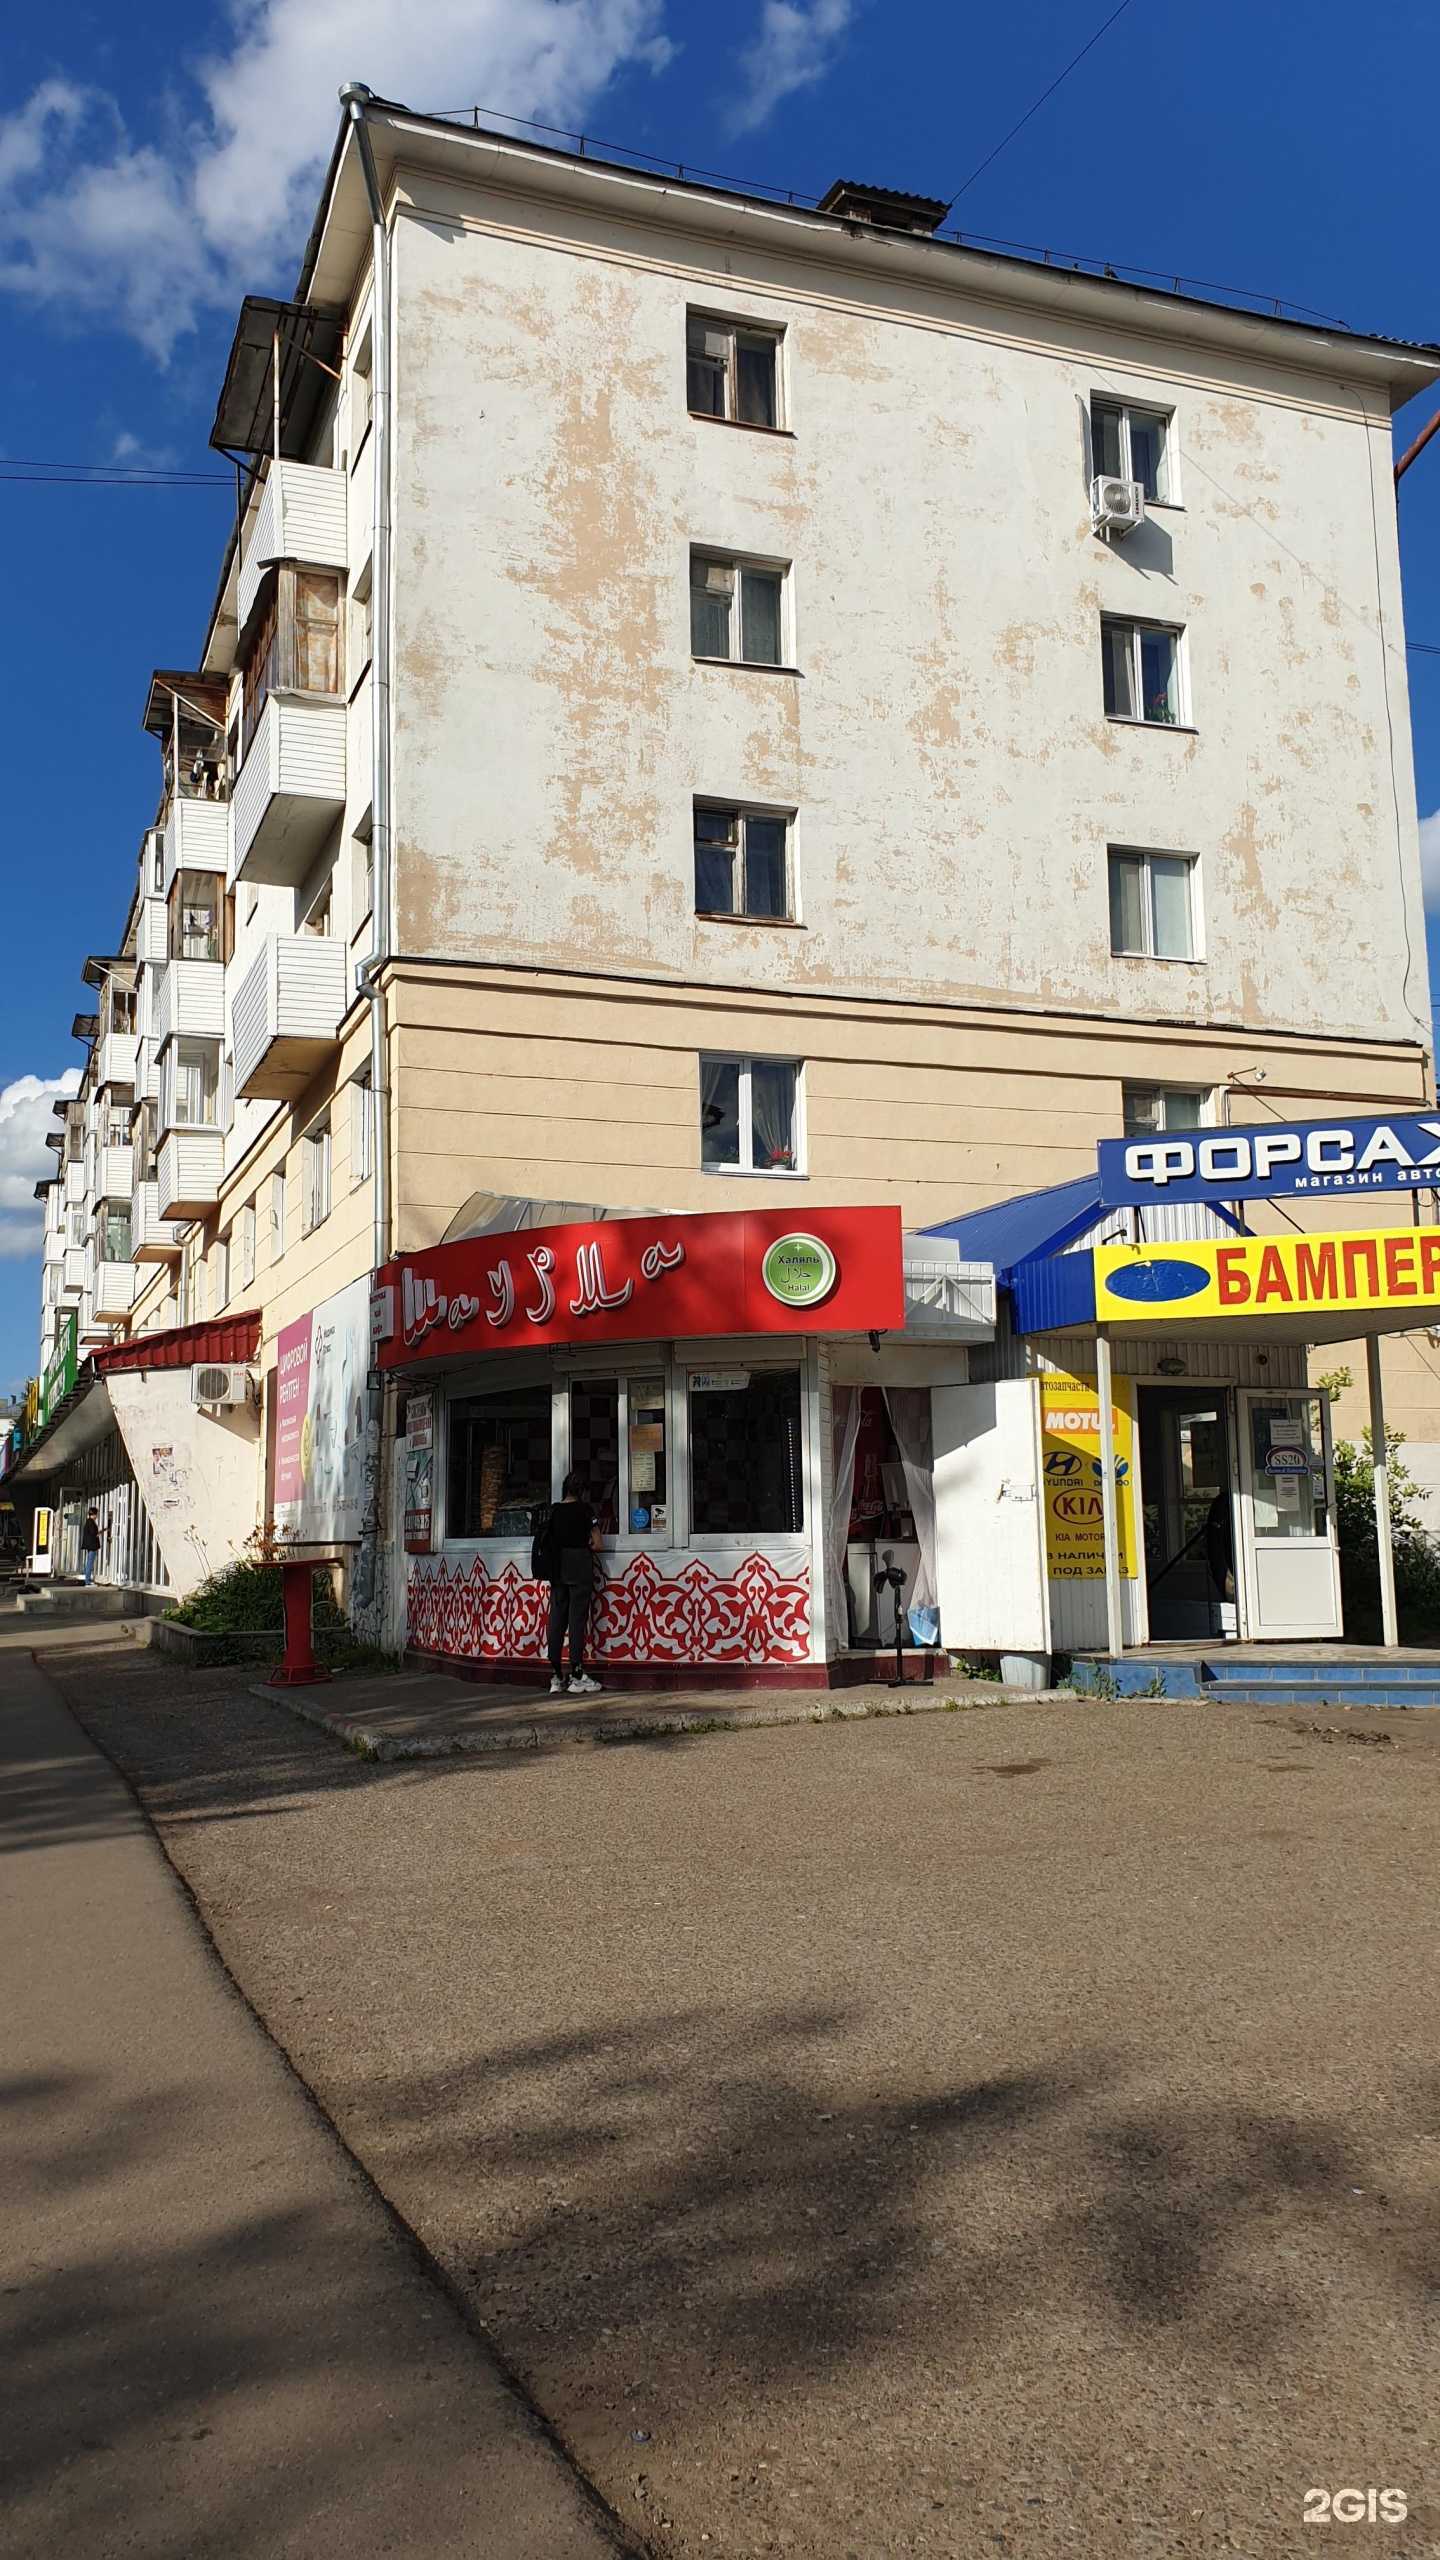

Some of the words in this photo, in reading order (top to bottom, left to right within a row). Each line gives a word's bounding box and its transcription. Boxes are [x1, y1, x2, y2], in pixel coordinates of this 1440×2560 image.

[1295, 1171, 1382, 1187] магазин
[778, 1255, 820, 1264] Халяль
[780, 1266, 811, 1284] حلال
[1216, 1236, 1440, 1305] БАМПЕР
[1040, 1382, 1090, 1392] втозапчасти
[1045, 1412, 1115, 1430] MOTU
[1274, 1454, 1300, 1466] SS20
[1044, 1479, 1083, 1487] YUNDAI
[1062, 1497, 1103, 1515] KIA
[1055, 1533, 1070, 1541] KIA
[1075, 1532, 1105, 1541] MOTOR
[1053, 1567, 1082, 1575] ПОД
[1087, 1566, 1128, 1574] ЗАЗ
